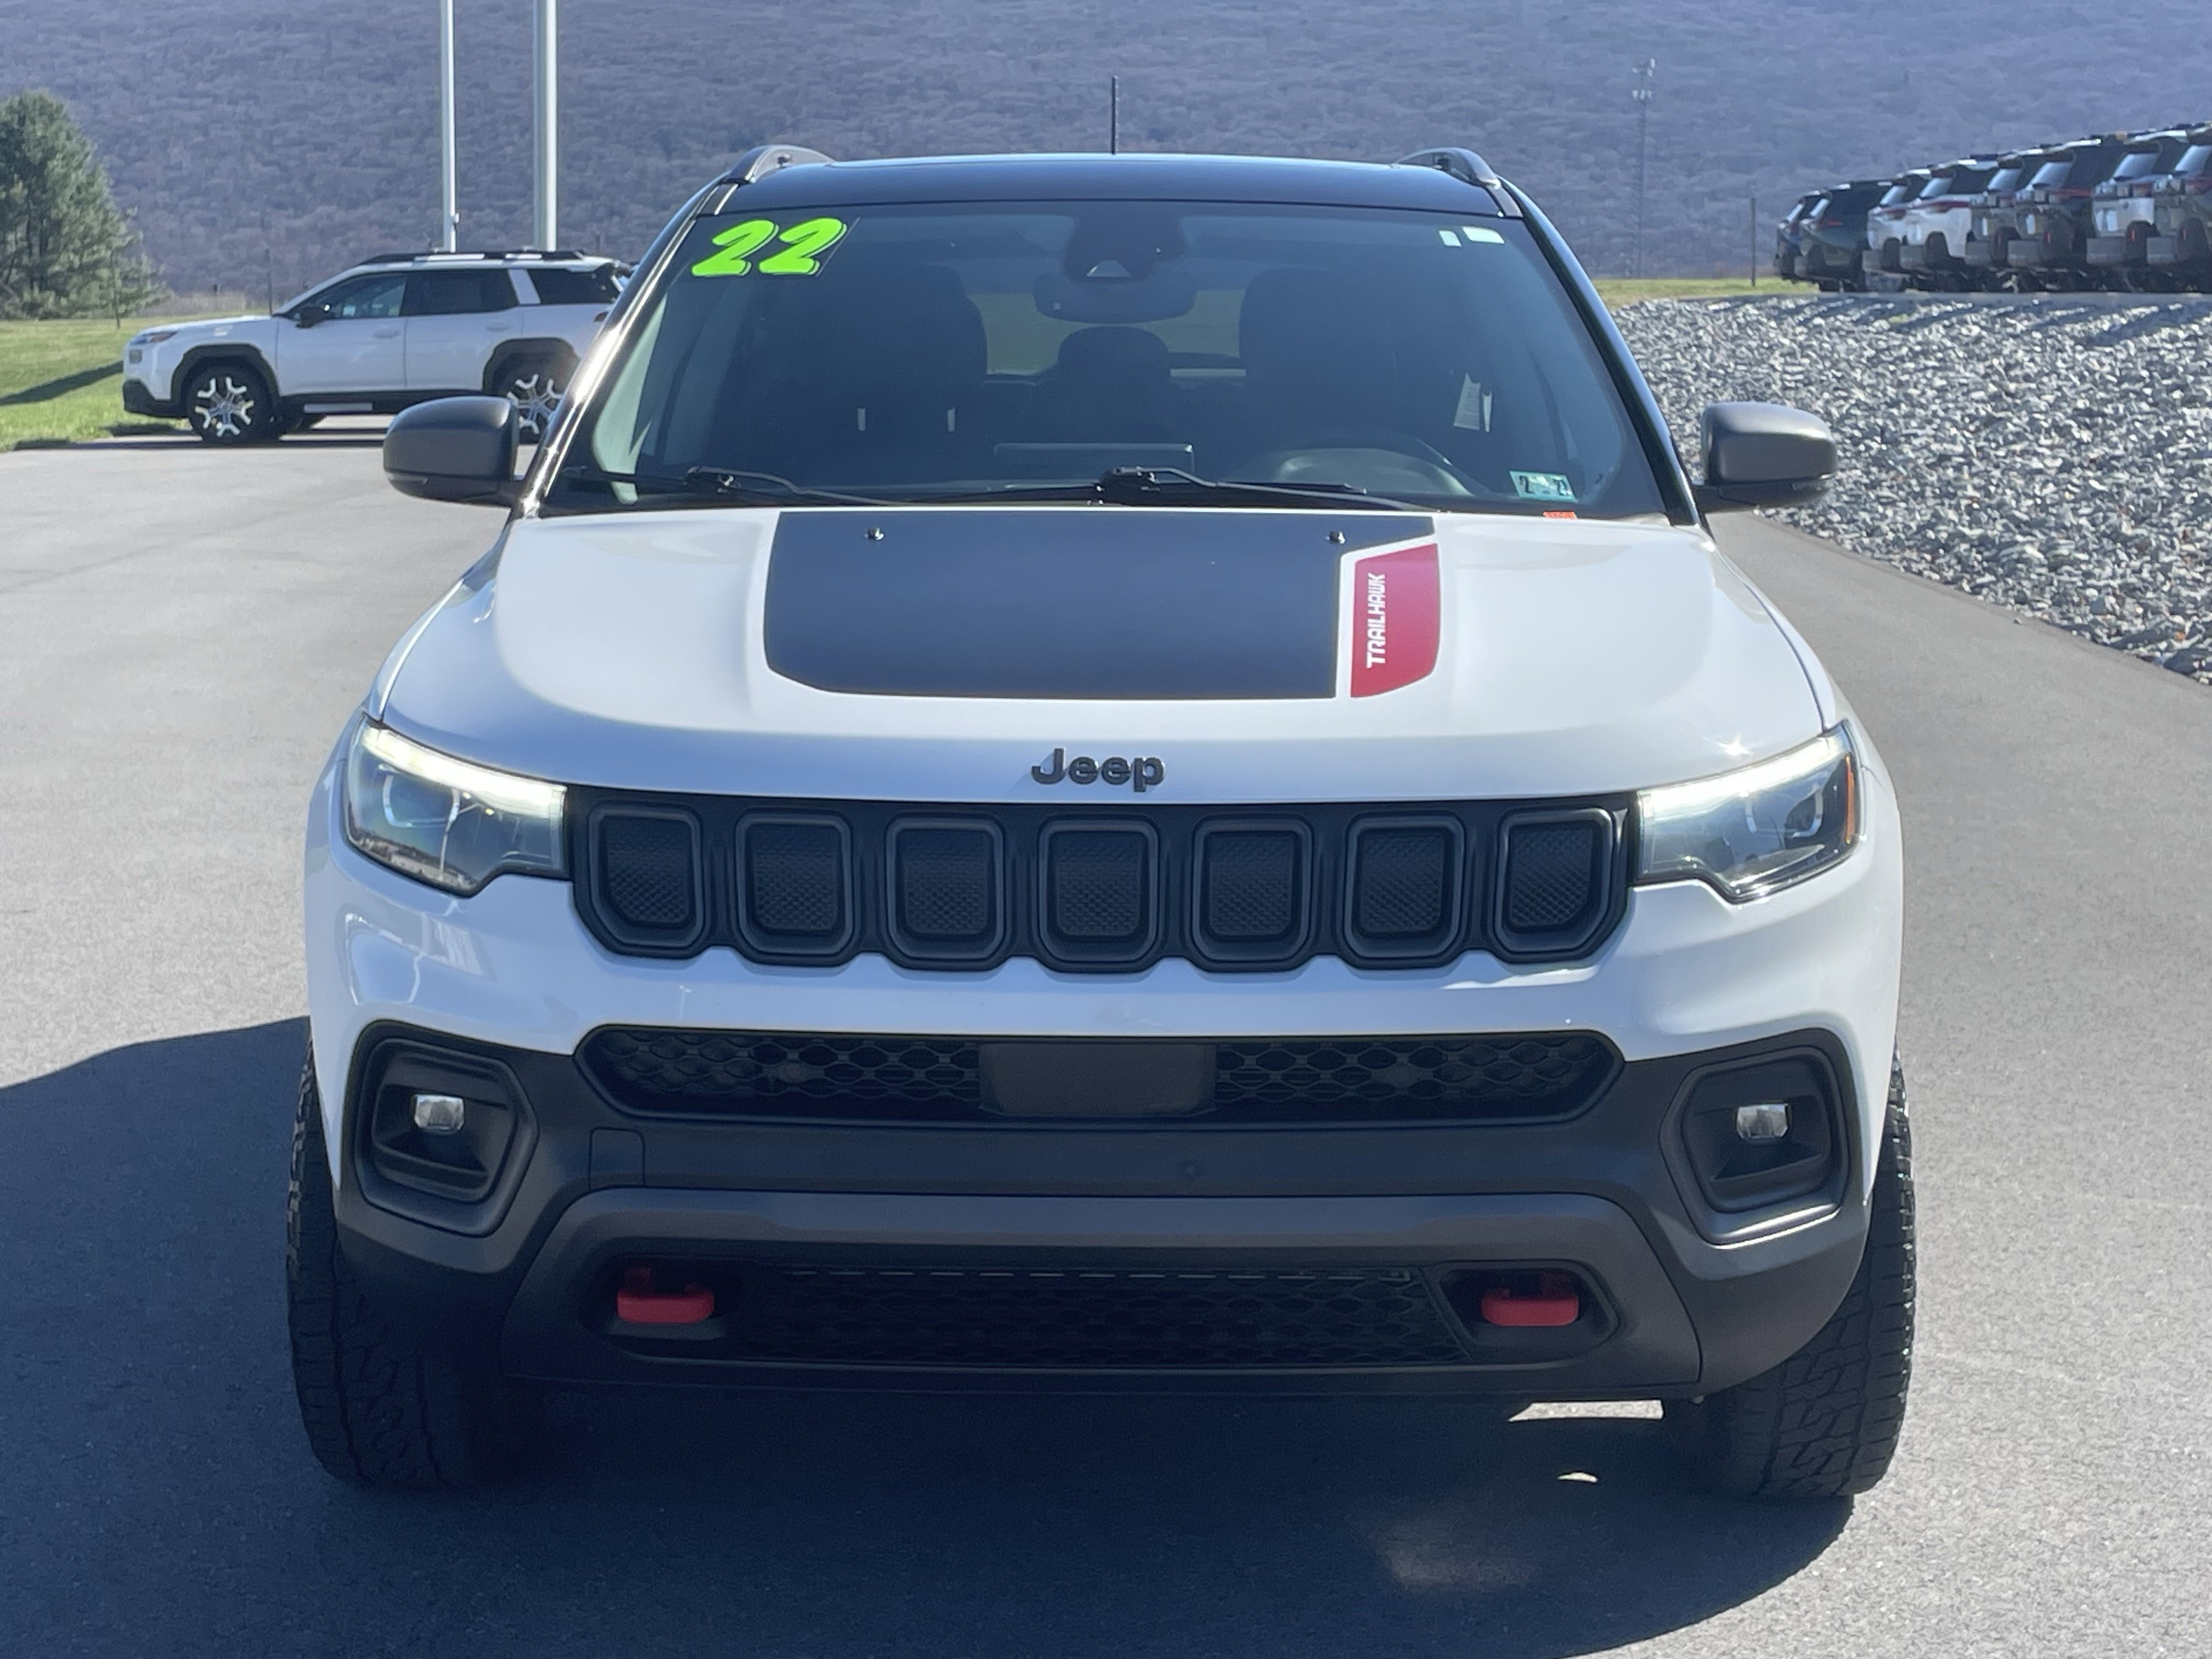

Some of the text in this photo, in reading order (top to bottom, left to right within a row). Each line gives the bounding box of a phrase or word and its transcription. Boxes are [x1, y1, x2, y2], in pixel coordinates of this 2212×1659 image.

[691, 217, 848, 276] 22
[1367, 572, 1386, 669] TRAILHAWK
[1031, 748, 1164, 792] Jeep
